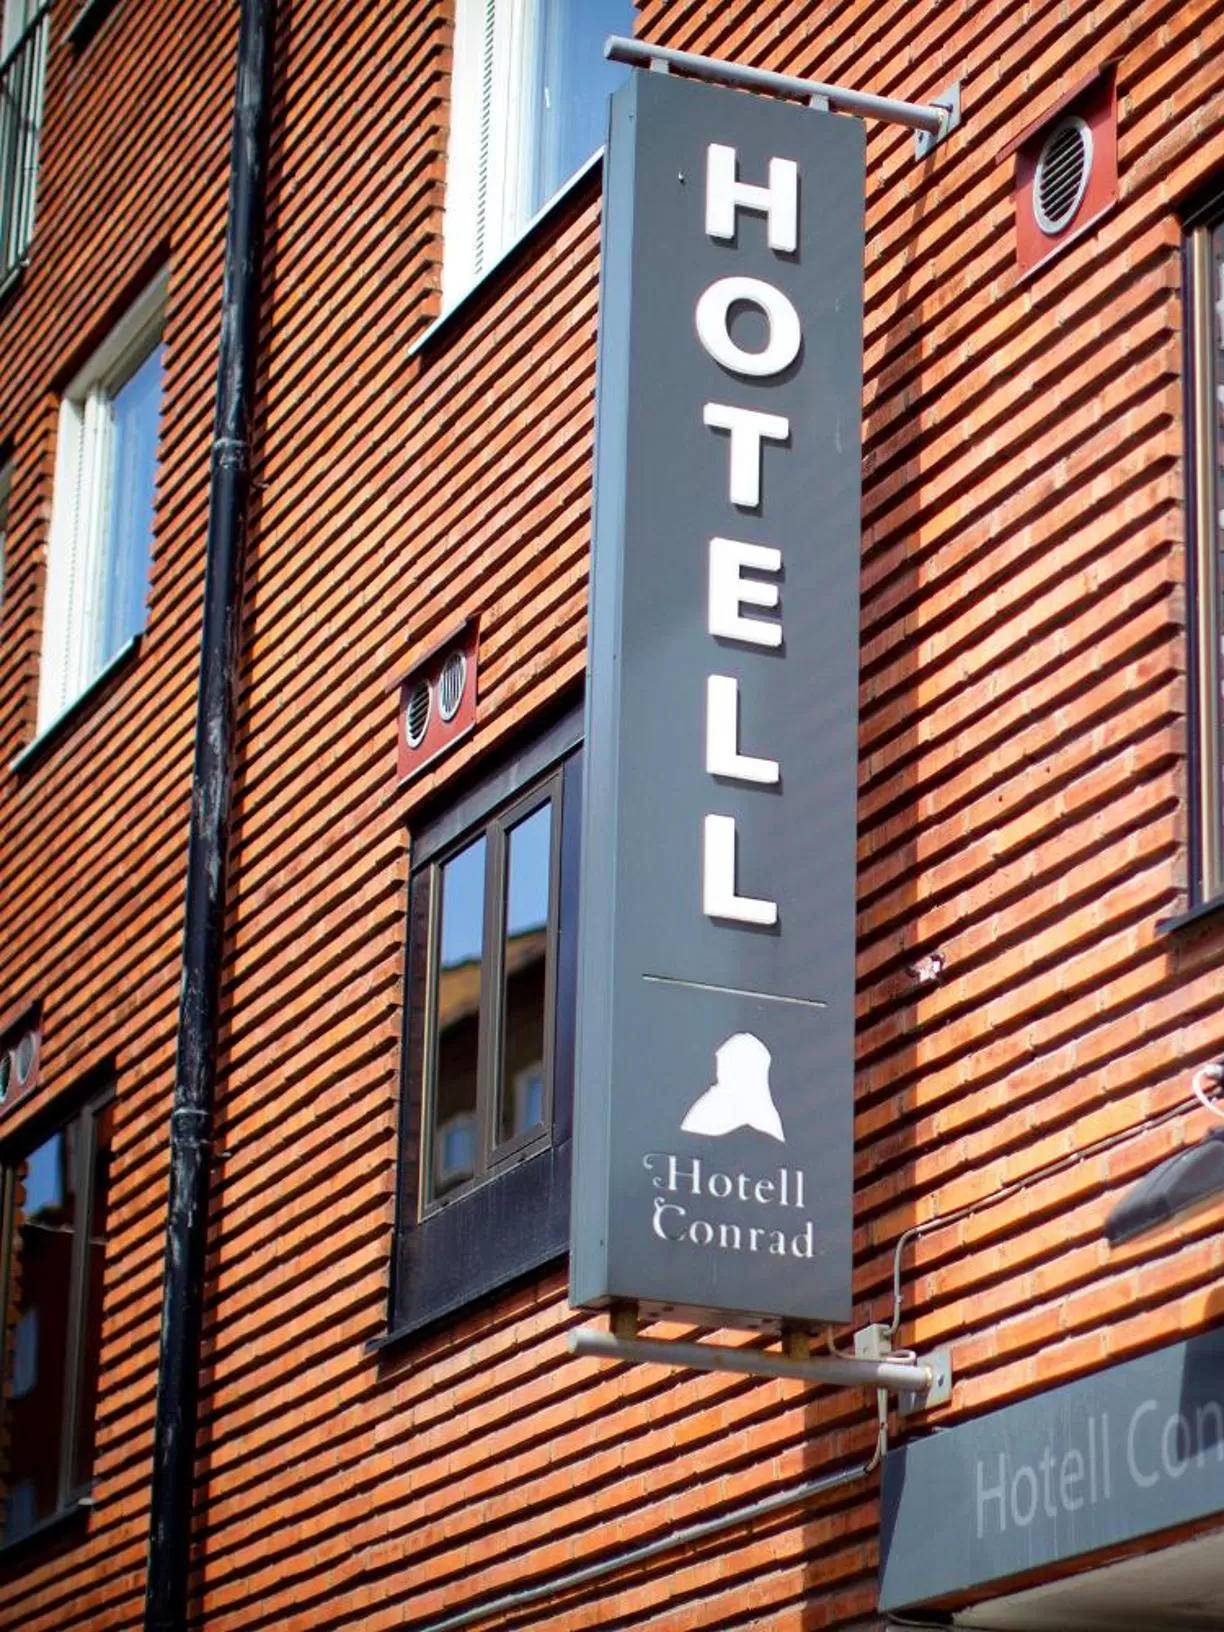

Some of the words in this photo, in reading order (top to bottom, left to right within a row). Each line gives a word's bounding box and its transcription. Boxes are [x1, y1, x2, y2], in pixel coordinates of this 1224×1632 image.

[696, 143, 801, 926] HOTELL
[642, 1153, 806, 1209] Hotell
[651, 1197, 815, 1259] Conrad
[974, 1411, 1112, 1539] Hotell
